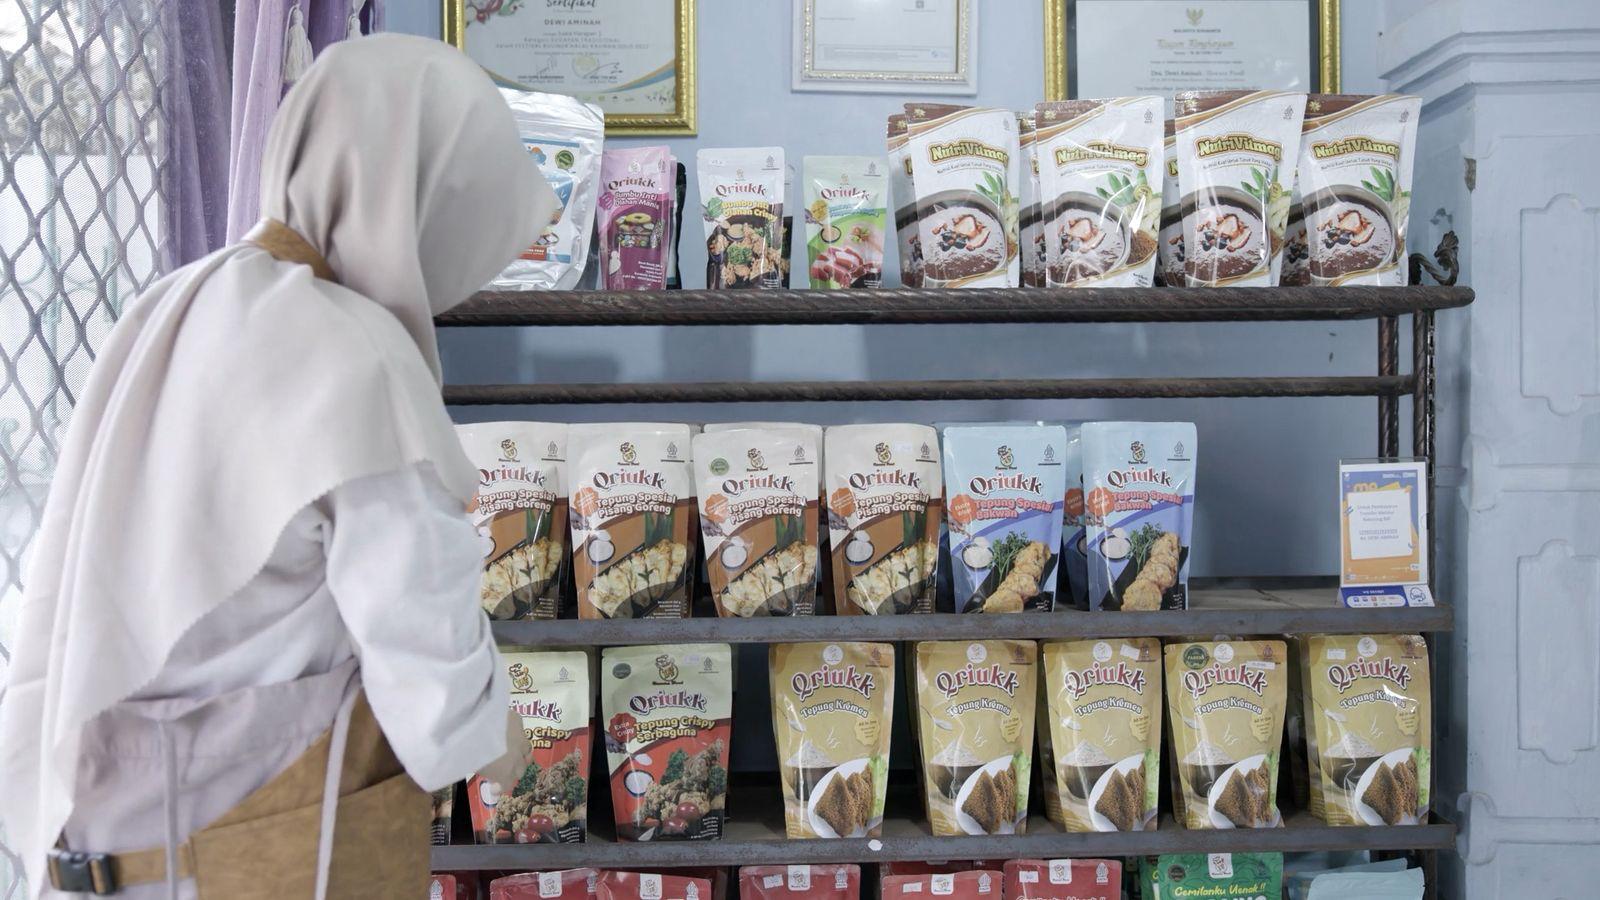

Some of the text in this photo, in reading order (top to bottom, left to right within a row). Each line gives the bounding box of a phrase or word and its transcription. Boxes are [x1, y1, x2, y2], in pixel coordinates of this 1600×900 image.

[608, 176, 656, 191] Qriukk
[716, 182, 767, 198] Qriukk
[821, 186, 870, 201] Qriukk
[479, 465, 546, 487] Qriukk
[593, 468, 665, 490] Qriukk
[849, 468, 921, 490] Qriukk
[969, 473, 1043, 496] Qriukk
[1107, 467, 1174, 488] Qriukk
[722, 474, 794, 496] Qriukk
[477, 489, 556, 504] Tepung Spesial
[596, 495, 636, 508] Tepung
[638, 492, 677, 504] Spesial
[728, 498, 767, 514] Tepung
[767, 495, 807, 507] Spesial
[855, 494, 894, 508] Tepung
[894, 492, 930, 503] Spesial
[976, 499, 1016, 510] Tepung
[1016, 497, 1055, 513] Spesial
[1113, 490, 1184, 506] Tepung Spesial
[480, 499, 552, 515] Pisang Goreng
[598, 503, 672, 518] Pisang Goreng
[856, 502, 925, 519] Pisang Goreng
[976, 508, 1019, 520] Bakwan
[1114, 500, 1152, 512] Bakwan
[730, 506, 802, 525] Pisang Goreng
[792, 663, 876, 699] Qriukk
[936, 663, 1019, 699] Qriukk
[1065, 661, 1147, 699] Qriukk
[1184, 662, 1267, 699] Qriukk
[1328, 657, 1411, 694] Qriukk
[630, 691, 707, 714] Qriukk
[945, 700, 980, 717] Tepung
[1074, 699, 1109, 716] Tepung
[1194, 699, 1229, 715] Tepung
[1340, 691, 1375, 709] Tepung
[510, 700, 562, 721] iukk
[801, 701, 834, 718] Tepung
[634, 715, 715, 732] Tepung Crispy
[534, 726, 573, 740] Crispy
[636, 727, 697, 743] Serbaguna
[1174, 886, 1226, 897] Cemilanku
[1229, 883, 1258, 895] Uenak
